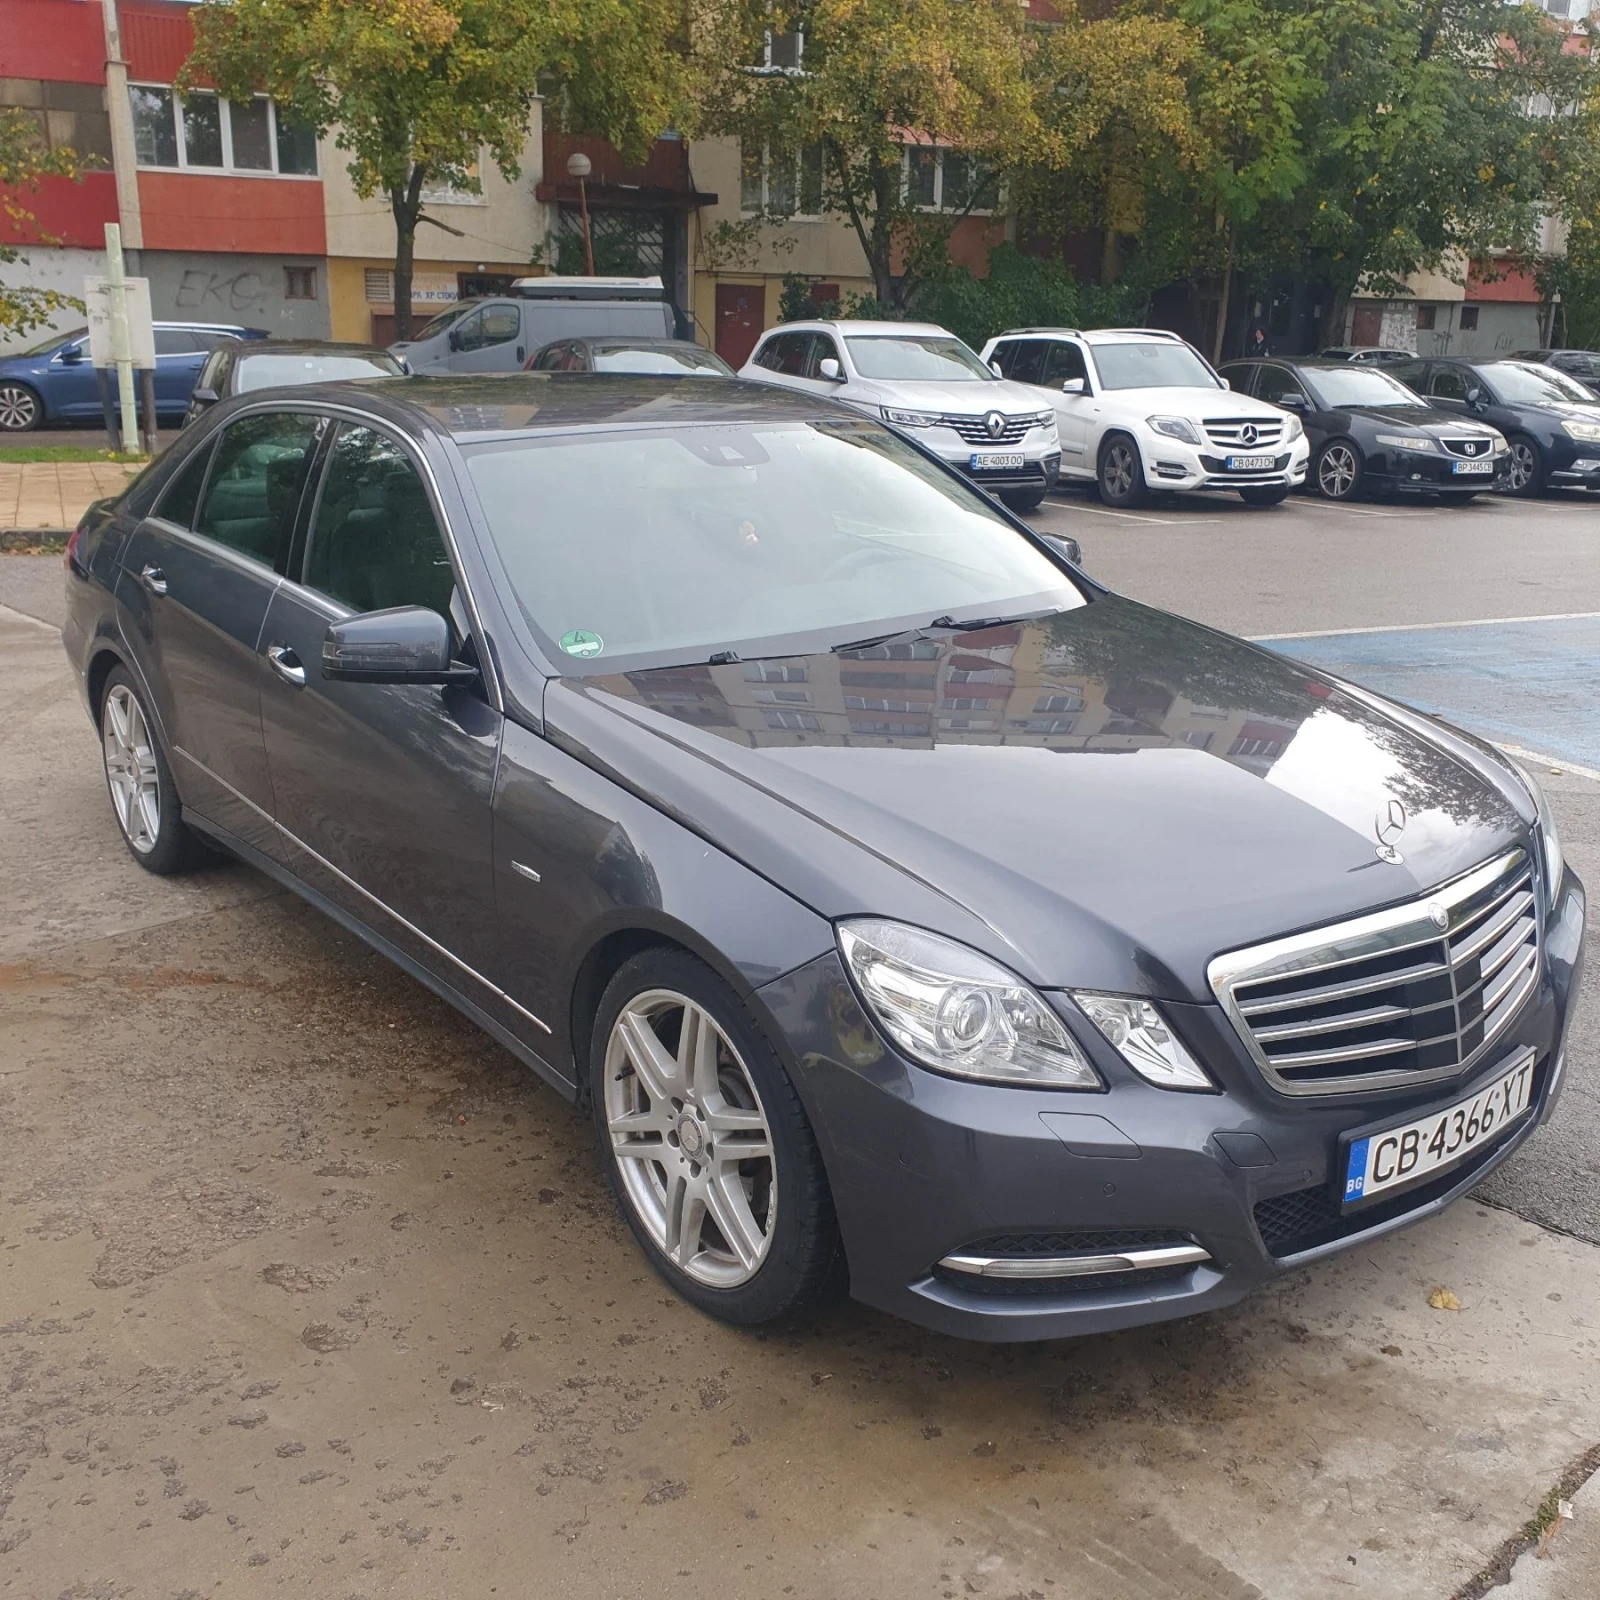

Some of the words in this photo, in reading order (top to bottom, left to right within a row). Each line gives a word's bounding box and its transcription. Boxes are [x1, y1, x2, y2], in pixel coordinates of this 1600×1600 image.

[977, 456, 989, 465] AE
[990, 456, 1010, 465] 4003
[1233, 459, 1244, 468] CB
[1245, 458, 1263, 468] 0473
[1264, 457, 1274, 467] CH
[574, 631, 586, 643] 4
[1372, 1129, 1420, 1183] CB
[1427, 1088, 1495, 1160] 4366
[1498, 1064, 1531, 1122] XT
[1346, 1176, 1363, 1193] BG
